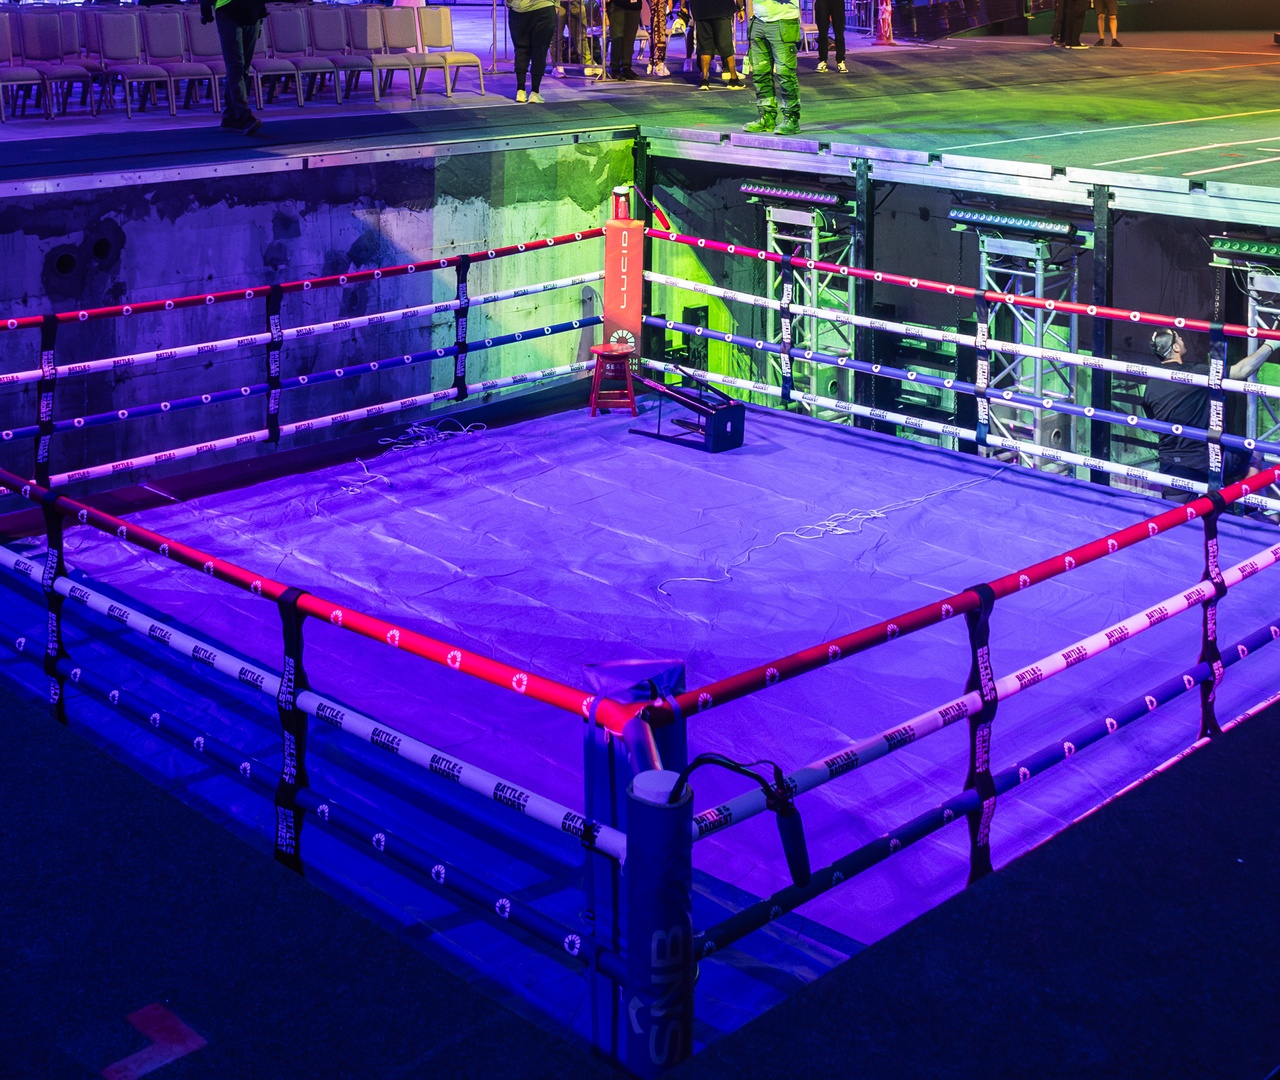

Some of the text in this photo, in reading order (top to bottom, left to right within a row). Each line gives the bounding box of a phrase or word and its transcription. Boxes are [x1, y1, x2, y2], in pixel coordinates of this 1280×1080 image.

[620, 230, 628, 308] LUCID
[192, 645, 213, 661] BATTLE
[1062, 647, 1081, 661] BATTLE
[239, 667, 260, 683] BATTLE
[1016, 667, 1036, 683] BATTLE
[317, 703, 340, 720] BATTLE
[371, 727, 396, 746] BATTLE
[883, 727, 908, 743] BATTLE
[430, 754, 457, 772] BATTLE
[824, 752, 851, 769] BATTLE
[494, 782, 524, 801] BATTLE
[493, 791, 526, 813] BADDEST
[694, 808, 721, 826] BATTLE
[698, 815, 732, 836] BADDEST
